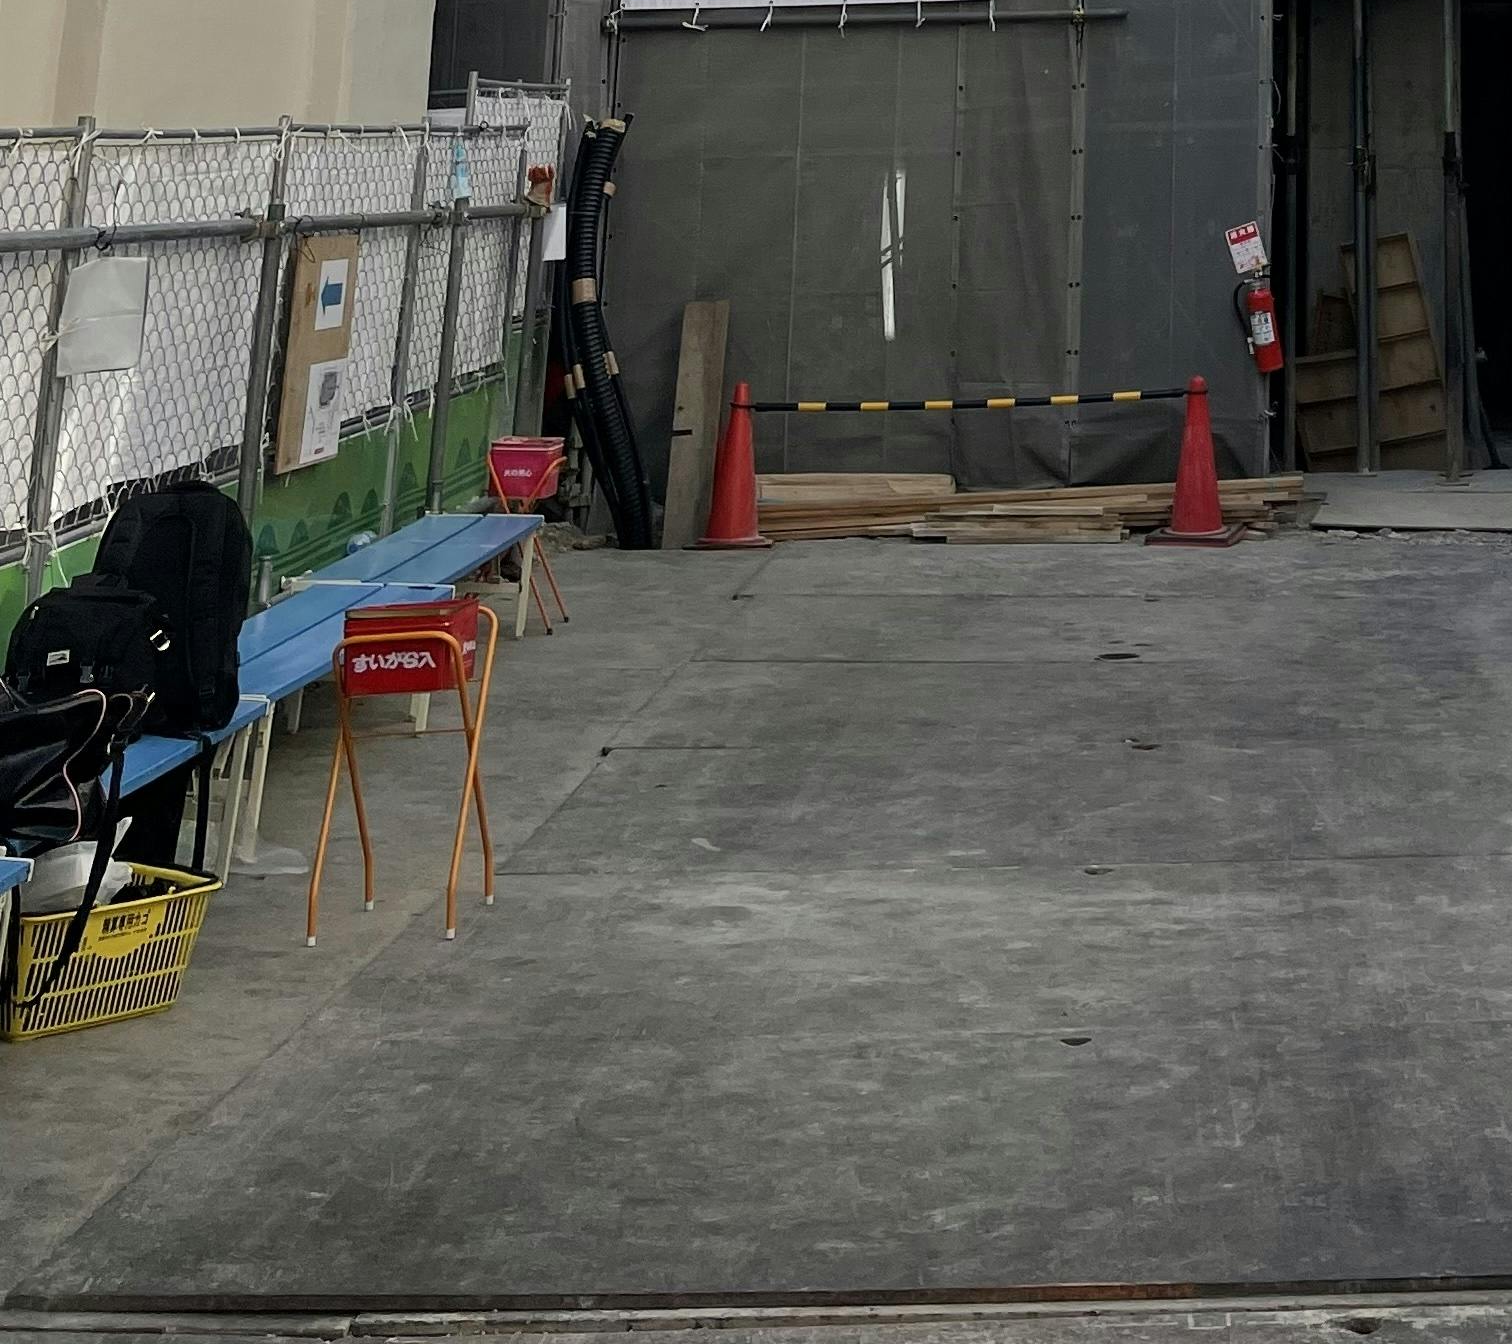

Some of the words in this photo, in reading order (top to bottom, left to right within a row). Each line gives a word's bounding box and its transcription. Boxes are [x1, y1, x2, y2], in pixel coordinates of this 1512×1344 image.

[352, 650, 437, 673] すいがら入
